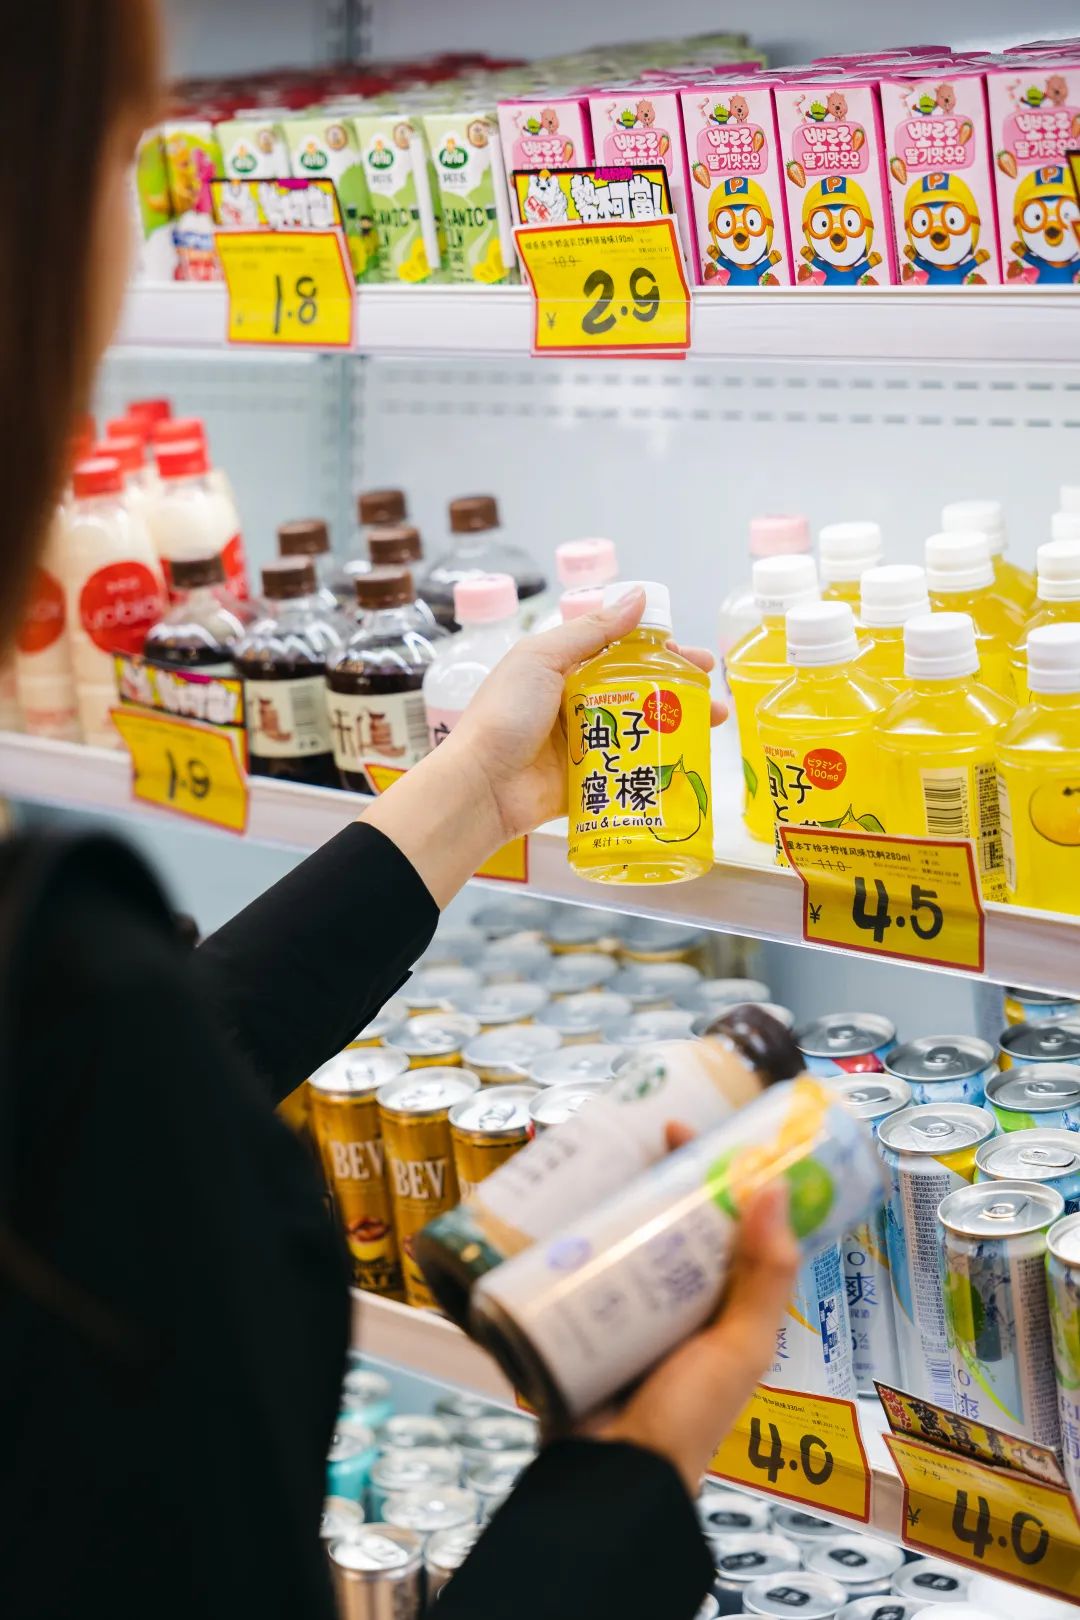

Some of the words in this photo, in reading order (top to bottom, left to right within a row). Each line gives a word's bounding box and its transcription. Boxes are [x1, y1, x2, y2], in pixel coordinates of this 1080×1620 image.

[706, 126, 753, 154] 뽀로로
[802, 125, 852, 153] 뽀로로
[906, 119, 959, 148] 뽀로로
[613, 132, 659, 158] 뽀로로
[904, 146, 966, 166] 딸기맛우유
[706, 152, 761, 170] 딸기맛우유
[802, 151, 861, 170] 딸기맛우유
[729, 176, 745, 193] P
[827, 176, 843, 193] P
[928, 173, 945, 190] P
[1041, 167, 1059, 184] P
[273, 275, 318, 334] 1.8
[582, 267, 660, 335] 2.9
[581, 711, 650, 751] 柚子
[602, 751, 620, 773] と
[807, 758, 843, 772] ビタミンC
[810, 767, 839, 782] 100mg
[600, 816, 609, 828] &
[612, 815, 663, 827] Lemon
[773, 799, 789, 822] と
[852, 876, 944, 943] 4.5
[748, 1417, 834, 1486] 4.0
[952, 1489, 1050, 1566] 4.0
